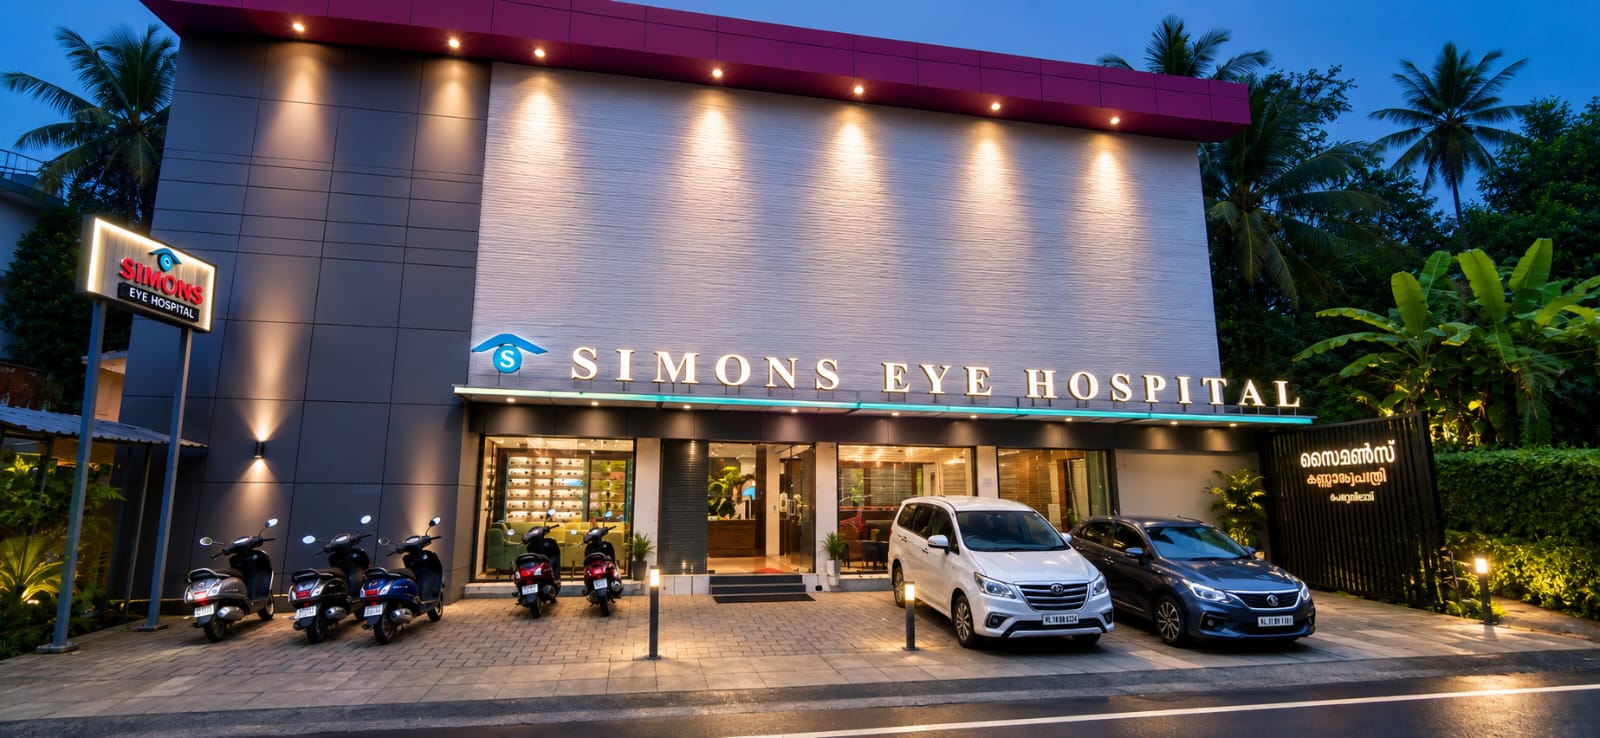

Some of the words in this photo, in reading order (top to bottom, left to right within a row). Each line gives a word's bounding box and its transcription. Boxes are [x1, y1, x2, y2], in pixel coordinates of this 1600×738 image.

[120, 258, 204, 305] SIMONS
[129, 287, 148, 303] EYE
[151, 296, 195, 319] HOSPITAL
[499, 349, 515, 368] S
[571, 346, 840, 391] SIMONS
[881, 362, 993, 396] EYE
[1024, 368, 1301, 408] HOSPITAL
